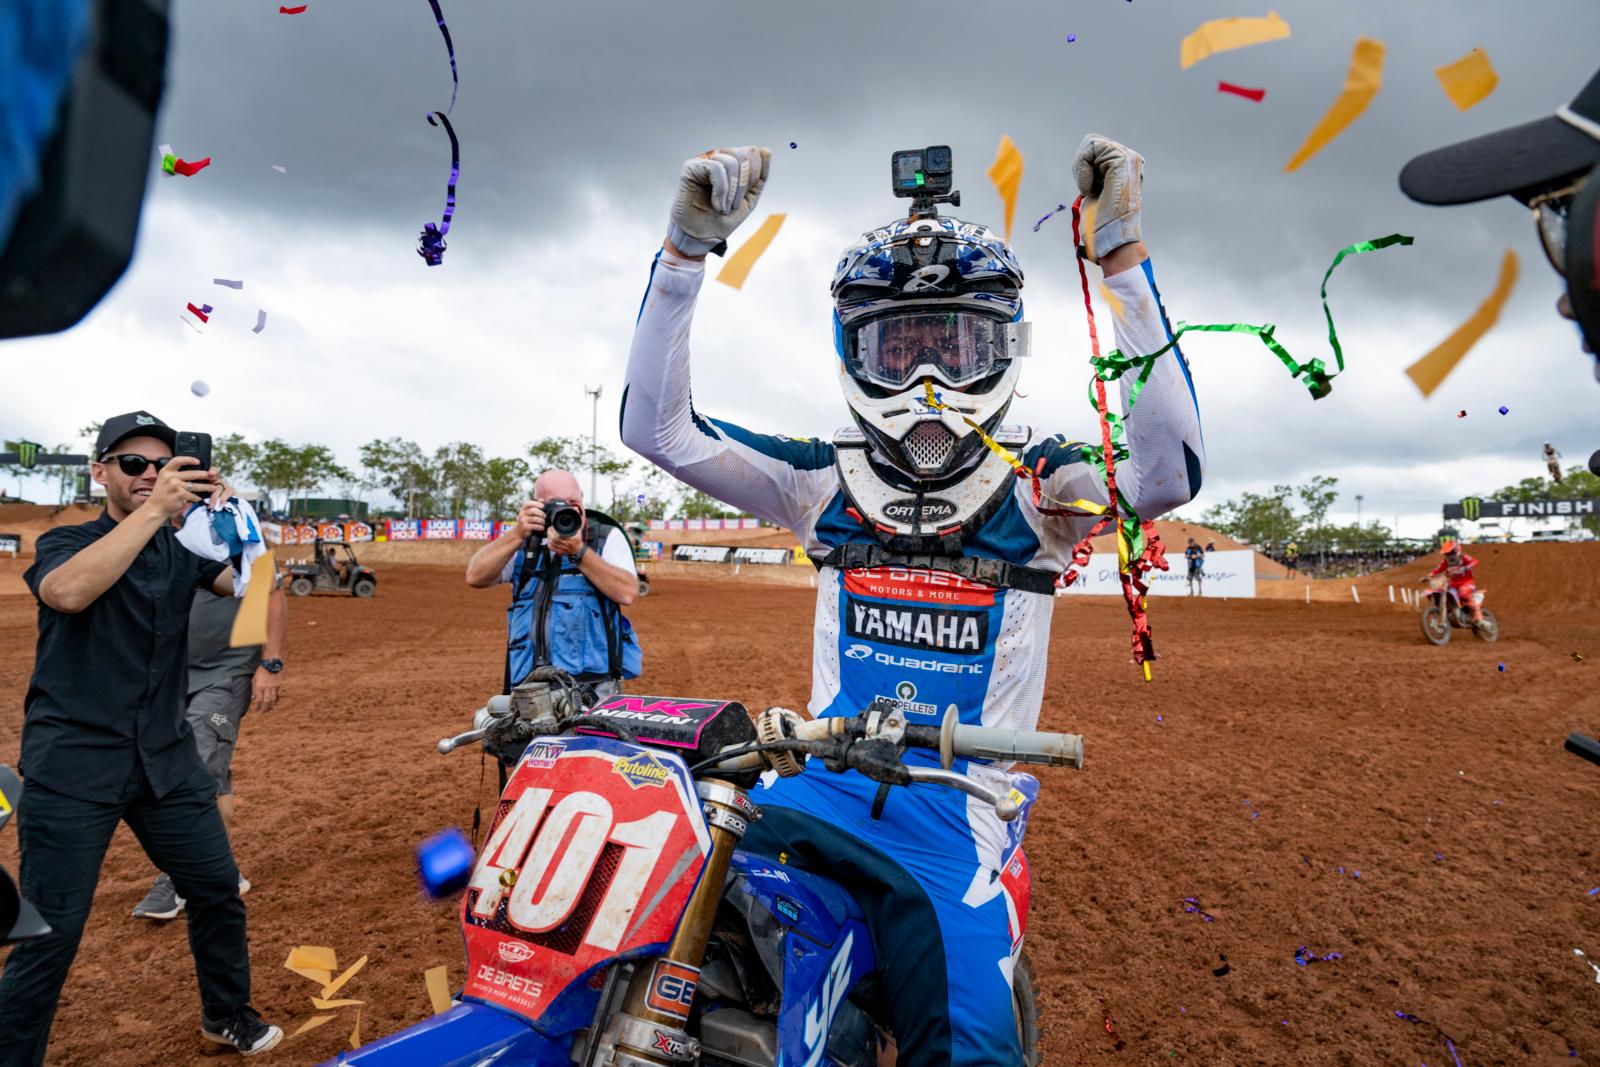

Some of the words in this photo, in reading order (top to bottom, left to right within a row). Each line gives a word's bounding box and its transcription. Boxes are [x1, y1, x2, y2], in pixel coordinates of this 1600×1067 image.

[886, 504, 952, 515] ORTEMA
[1502, 501, 1593, 515] FINISH
[870, 585, 912, 596] MOTORS
[929, 591, 960, 600] MORE
[853, 604, 980, 650] YAMAHA
[875, 652, 983, 675] quadrant
[615, 759, 668, 780] Putoline
[468, 787, 679, 952] 401
[477, 964, 496, 982] DE
[493, 970, 543, 998] BRETS
